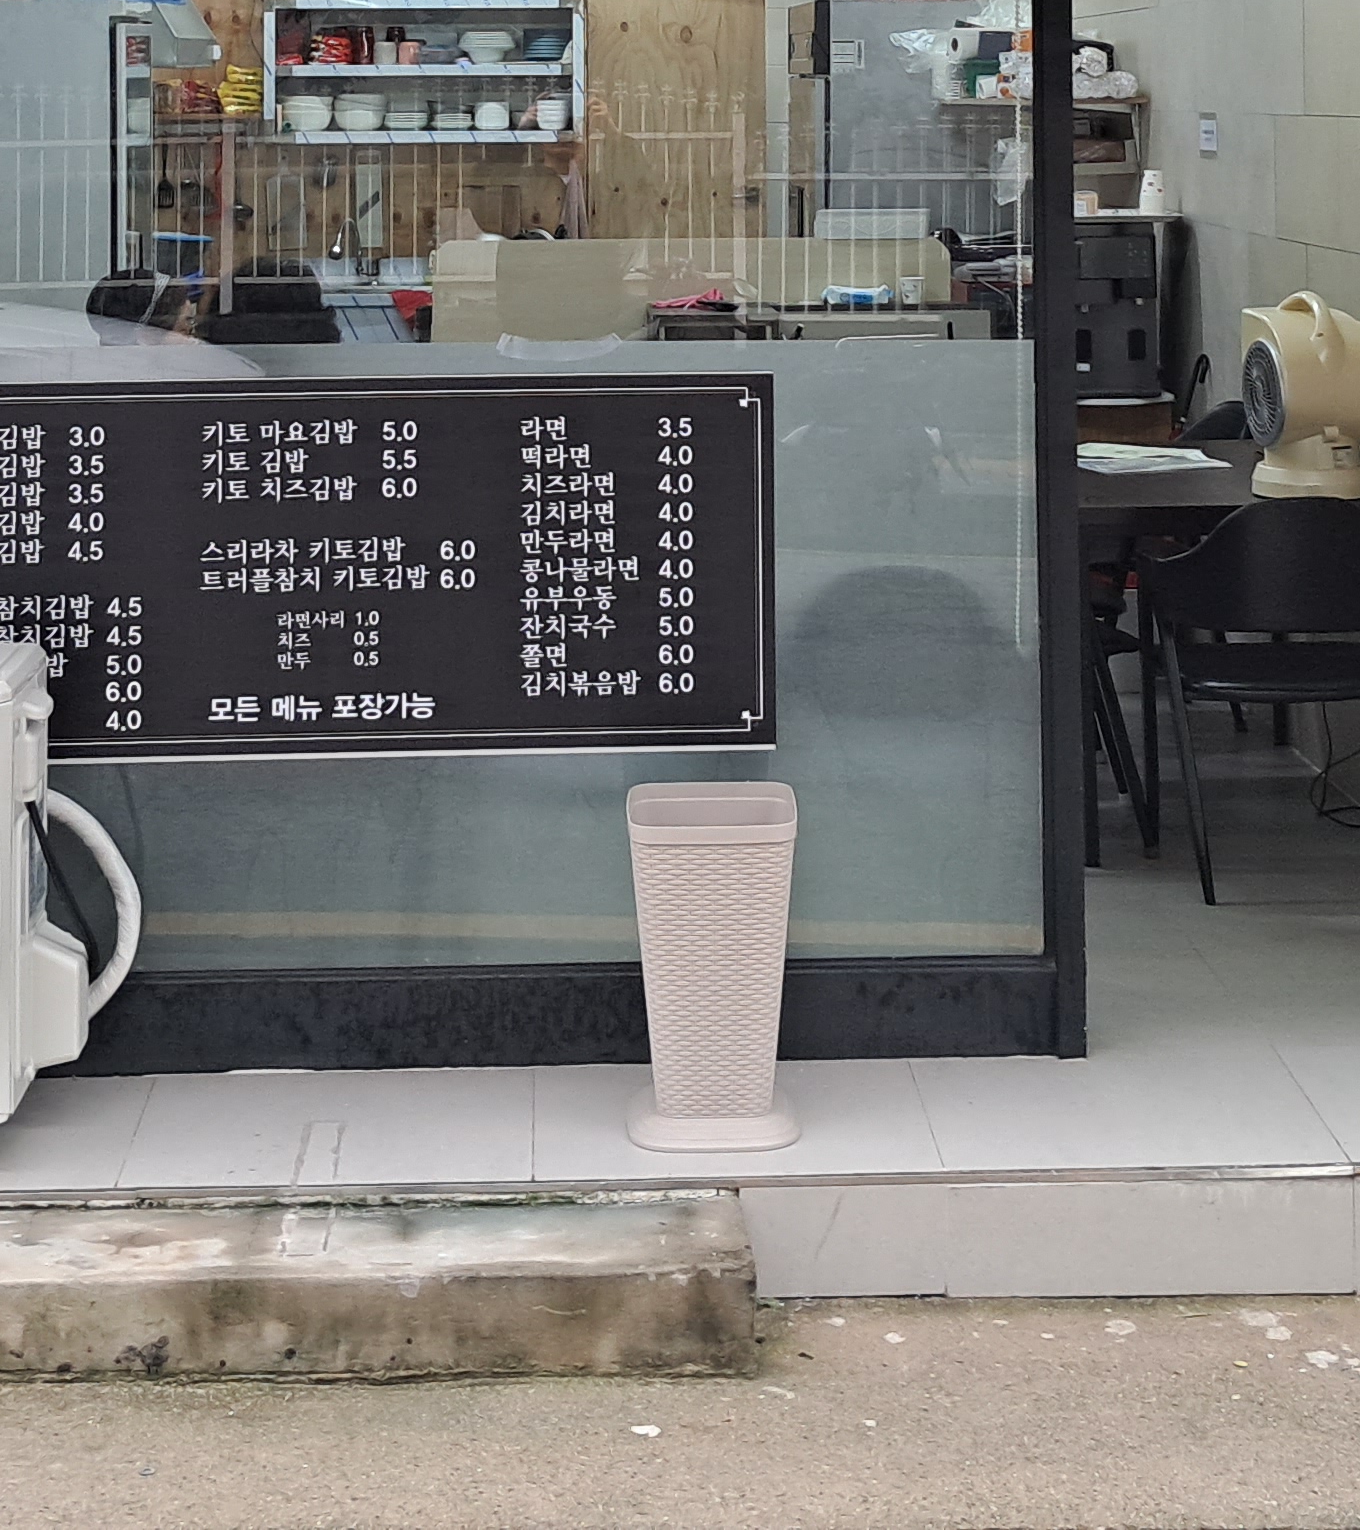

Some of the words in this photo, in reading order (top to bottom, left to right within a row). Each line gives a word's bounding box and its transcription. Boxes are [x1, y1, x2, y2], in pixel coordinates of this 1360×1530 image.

[68, 426, 105, 448] 3.0
[202, 421, 251, 447] 키토
[259, 418, 358, 446] 마요김밥
[382, 420, 418, 442] 5.0
[520, 415, 568, 442] 라면
[657, 417, 693, 439] 3.5
[68, 454, 104, 476] 3.5
[202, 449, 251, 476] 키토
[260, 447, 309, 475] 김밥
[382, 449, 417, 471] 5.5
[520, 443, 592, 470] 떡라면
[657, 445, 693, 467] 4.0
[68, 483, 104, 505] 3.5
[201, 477, 250, 504] 키토
[260, 475, 358, 503] 치즈김밥
[381, 477, 418, 499] 6.0
[520, 471, 616, 499] 치즈라면
[657, 473, 693, 495] 4.0
[67, 511, 104, 534] 4.0
[520, 499, 616, 527] 김치라면
[658, 501, 694, 523] 4.0
[67, 540, 104, 562] 4.5
[200, 538, 299, 565] 스리라차
[309, 536, 406, 564] 키토김밥
[440, 539, 476, 562] 6.0
[519, 527, 616, 555] 만두라면
[658, 529, 694, 552] 4.0
[199, 566, 320, 594] 트러플참치
[333, 563, 431, 592] 키토김밥
[439, 568, 476, 590] 6.0
[519, 555, 640, 583] 콩나물라면
[658, 558, 694, 580] 4.0
[107, 596, 142, 618] 4.5
[519, 585, 617, 613] 유부우동
[658, 586, 694, 609] 5.0
[277, 610, 345, 630] 라면사리
[355, 610, 380, 627] 1.0
[519, 613, 617, 640] 잔치국수
[659, 615, 694, 637] 5.0
[106, 625, 142, 647] 4.5
[277, 631, 312, 650] 치즈
[353, 630, 379, 647] 0.5
[106, 654, 142, 676] 5.0
[277, 651, 311, 670] 만두
[353, 650, 379, 667] 0.5
[519, 642, 568, 669] 쫄면
[658, 644, 694, 666] 6.0
[105, 680, 142, 703] 6.0
[520, 669, 642, 697] 김치볶음밥
[658, 672, 694, 695] 6.0
[105, 709, 142, 732] 4.0
[207, 696, 261, 723] 모든
[271, 694, 323, 722] 메뉴
[331, 692, 436, 720] 포장가능
